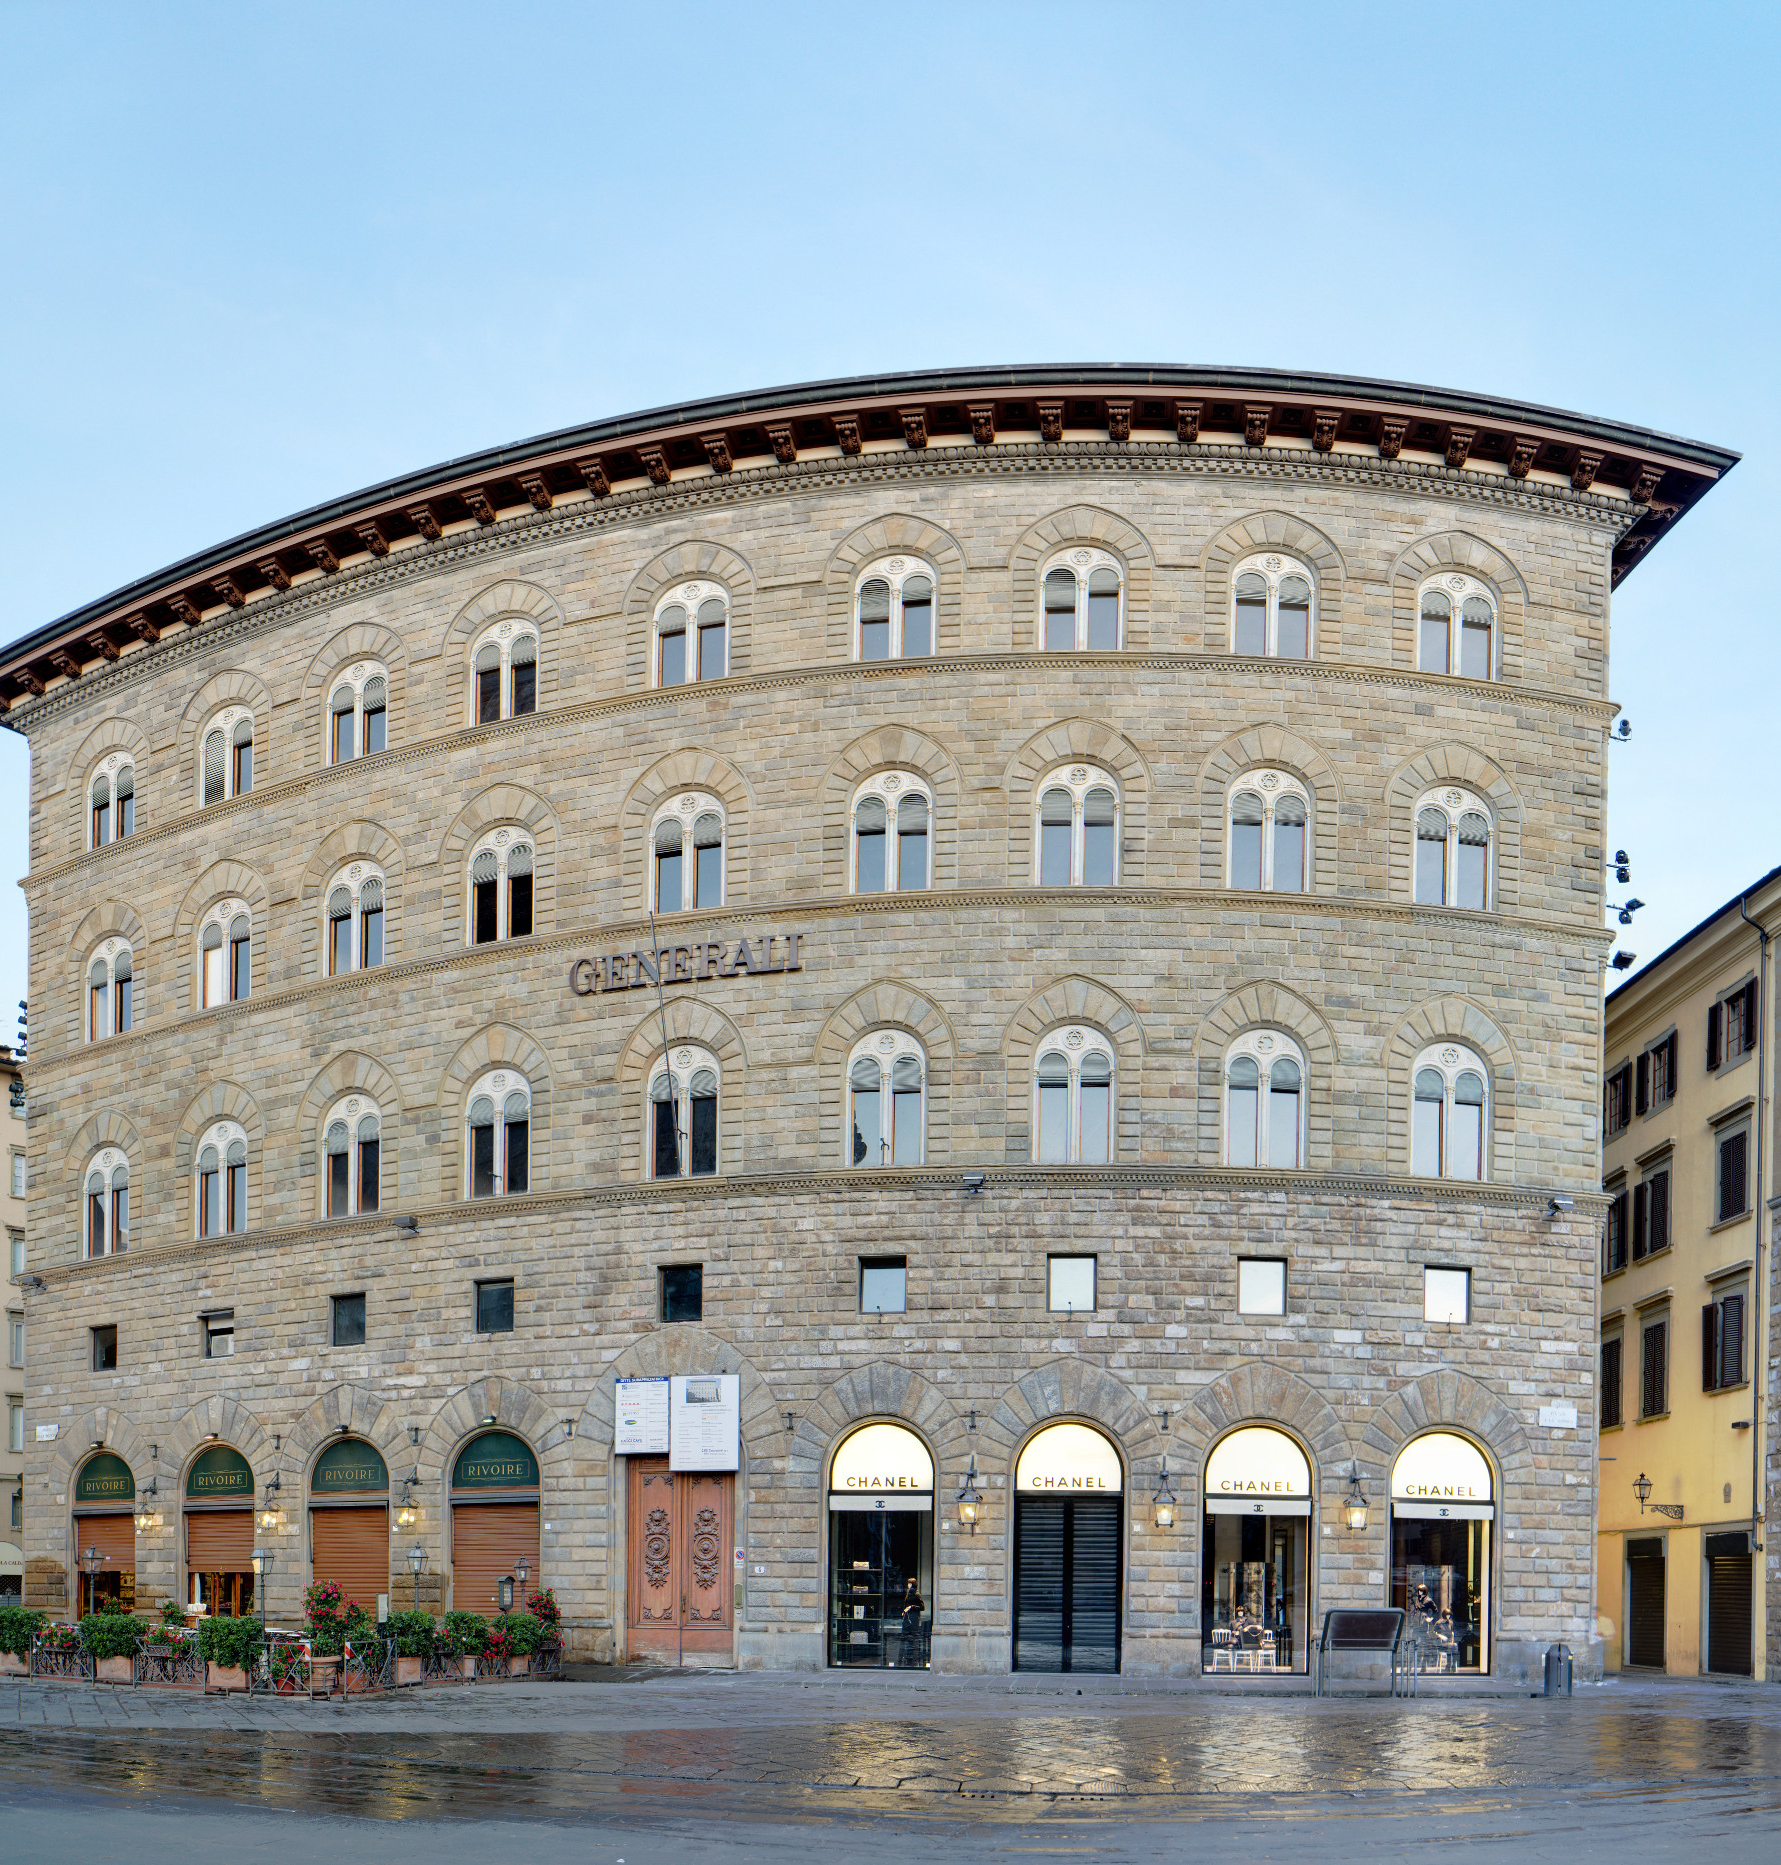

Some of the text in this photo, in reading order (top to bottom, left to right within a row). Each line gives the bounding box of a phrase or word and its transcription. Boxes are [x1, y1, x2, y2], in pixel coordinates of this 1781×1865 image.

[569, 933, 804, 996] GENERALI
[325, 1469, 375, 1481] RIVOIRE
[468, 1464, 523, 1476] RIVOIRE
[85, 1480, 126, 1492] RIVOIRE
[198, 1474, 243, 1487] RIVOIRE
[846, 1476, 919, 1487] CHANEL
[1031, 1476, 1106, 1488] CHANEL
[1221, 1480, 1295, 1492] CHANEL
[1405, 1484, 1477, 1497] CHANEL
